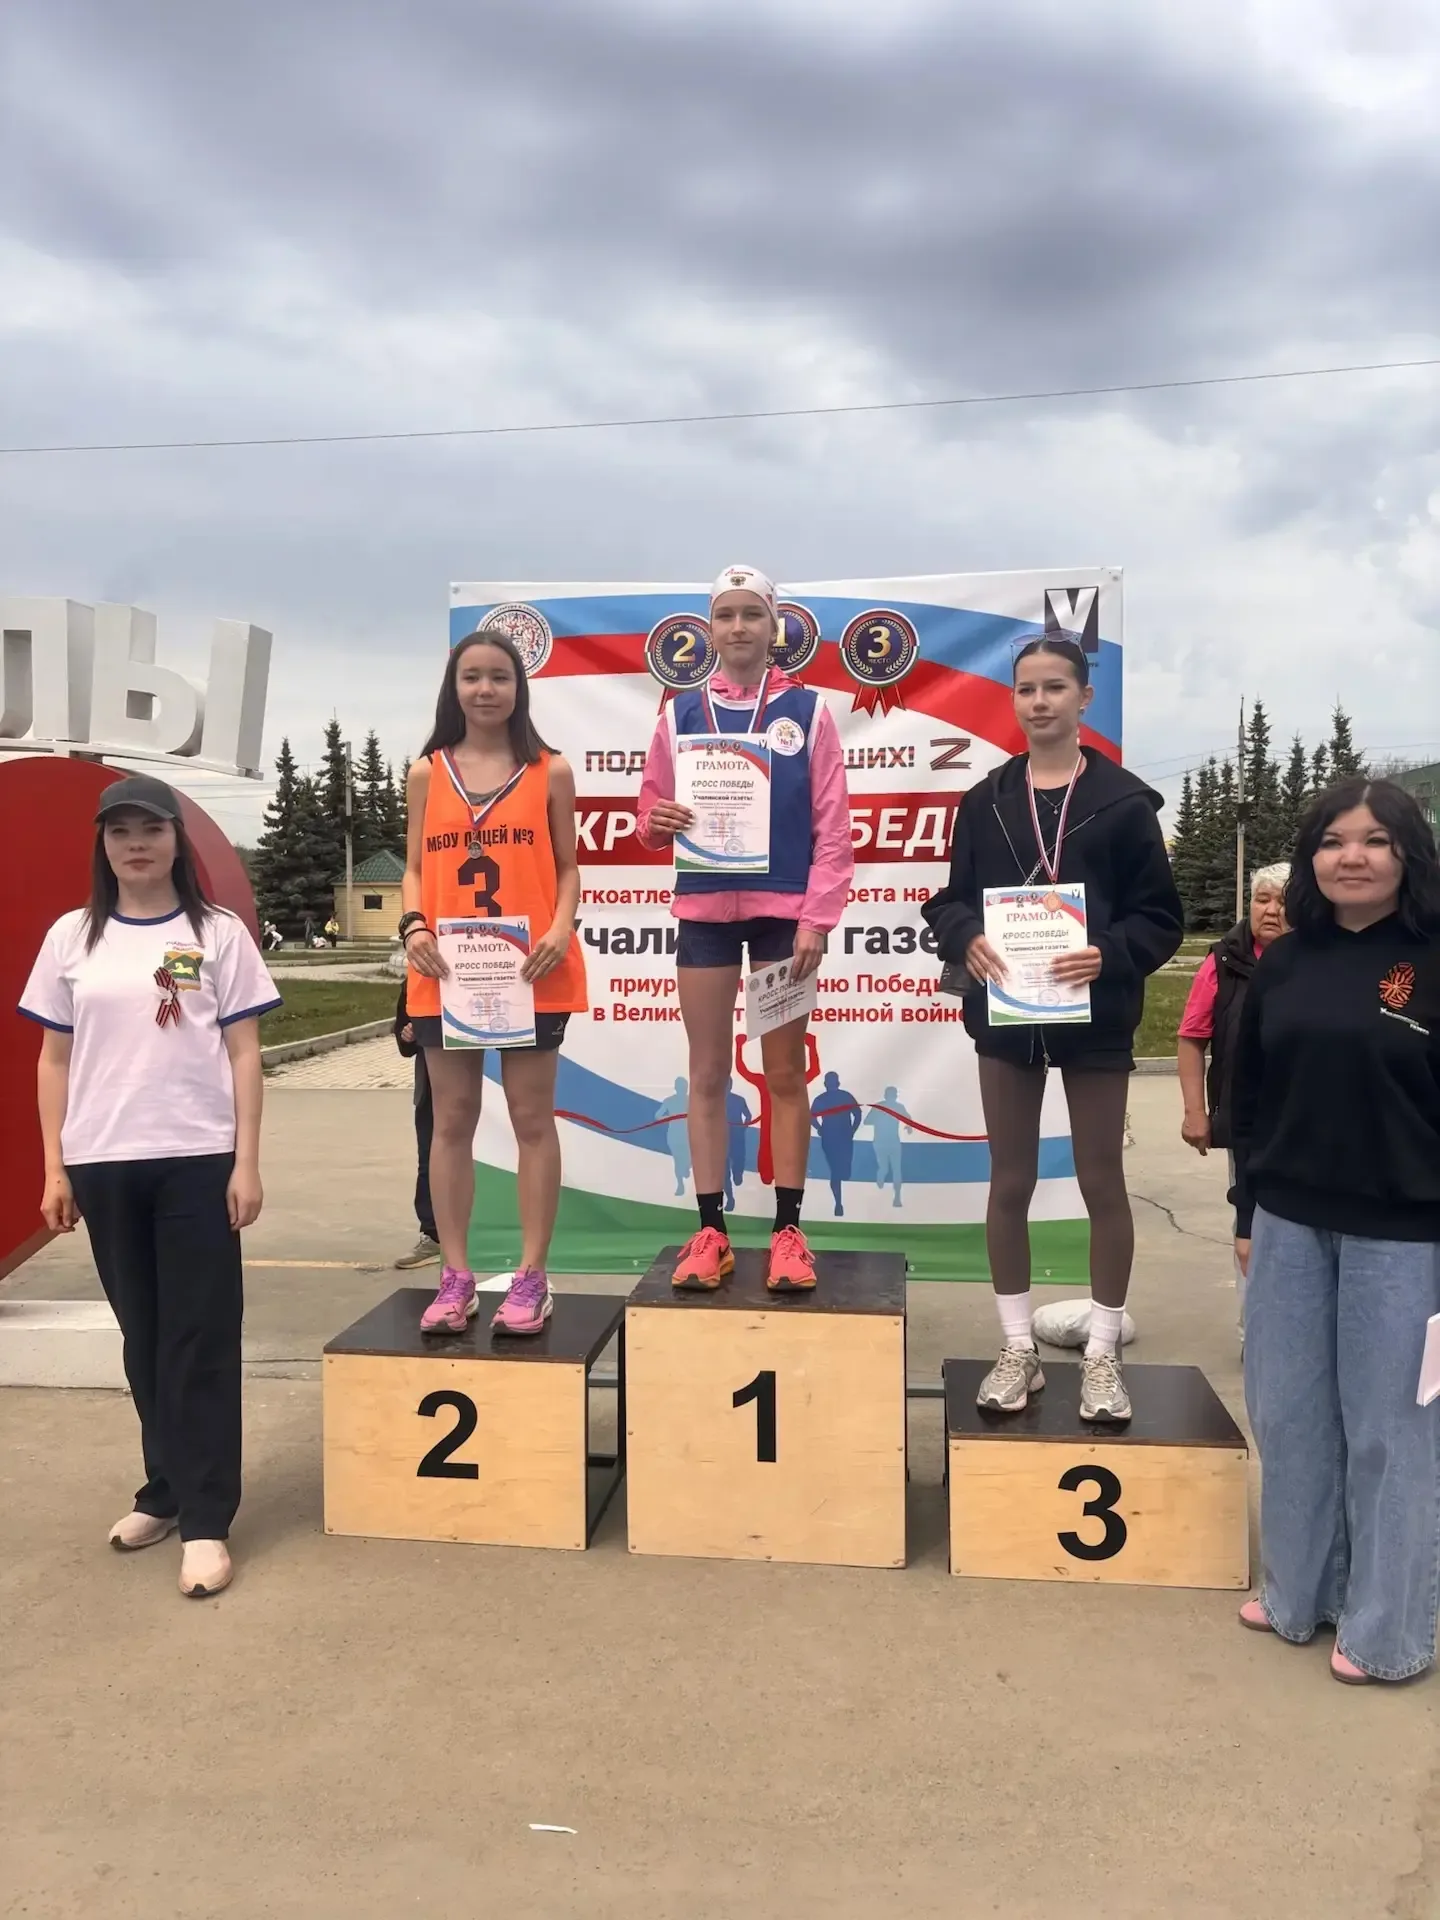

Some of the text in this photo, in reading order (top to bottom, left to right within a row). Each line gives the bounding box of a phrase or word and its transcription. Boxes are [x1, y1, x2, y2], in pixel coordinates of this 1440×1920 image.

[773, 618, 788, 647] 1
[868, 626, 891, 658] 3
[673, 631, 696, 662] 2
[586, 746, 915, 775] ПОД ШИХ!
[696, 761, 750, 770] ГРАМОТА
[691, 780, 754, 789] КРОСС ПОБЕДЫ
[427, 832, 459, 852] МБОУ
[513, 828, 534, 845] №3
[575, 806, 959, 857] КР БЕД
[579, 889, 676, 904] гкоатле
[904, 887, 930, 902] на
[1006, 911, 1063, 922] ГРАМОТА
[844, 926, 939, 955] газе
[1002, 929, 1069, 939] КРОСС ПОБЕДЫ
[457, 943, 511, 953] ГРАМОТА
[455, 961, 515, 970] КРОСС ПОБЕДЫ
[610, 978, 679, 997] приур
[817, 979, 849, 993] ню
[593, 1008, 605, 1021] в
[613, 1003, 682, 1021] Велик
[811, 1002, 893, 1022] венной
[733, 1370, 776, 1462] 1
[417, 1390, 479, 1479] 2
[1057, 1464, 1127, 1561] 3
